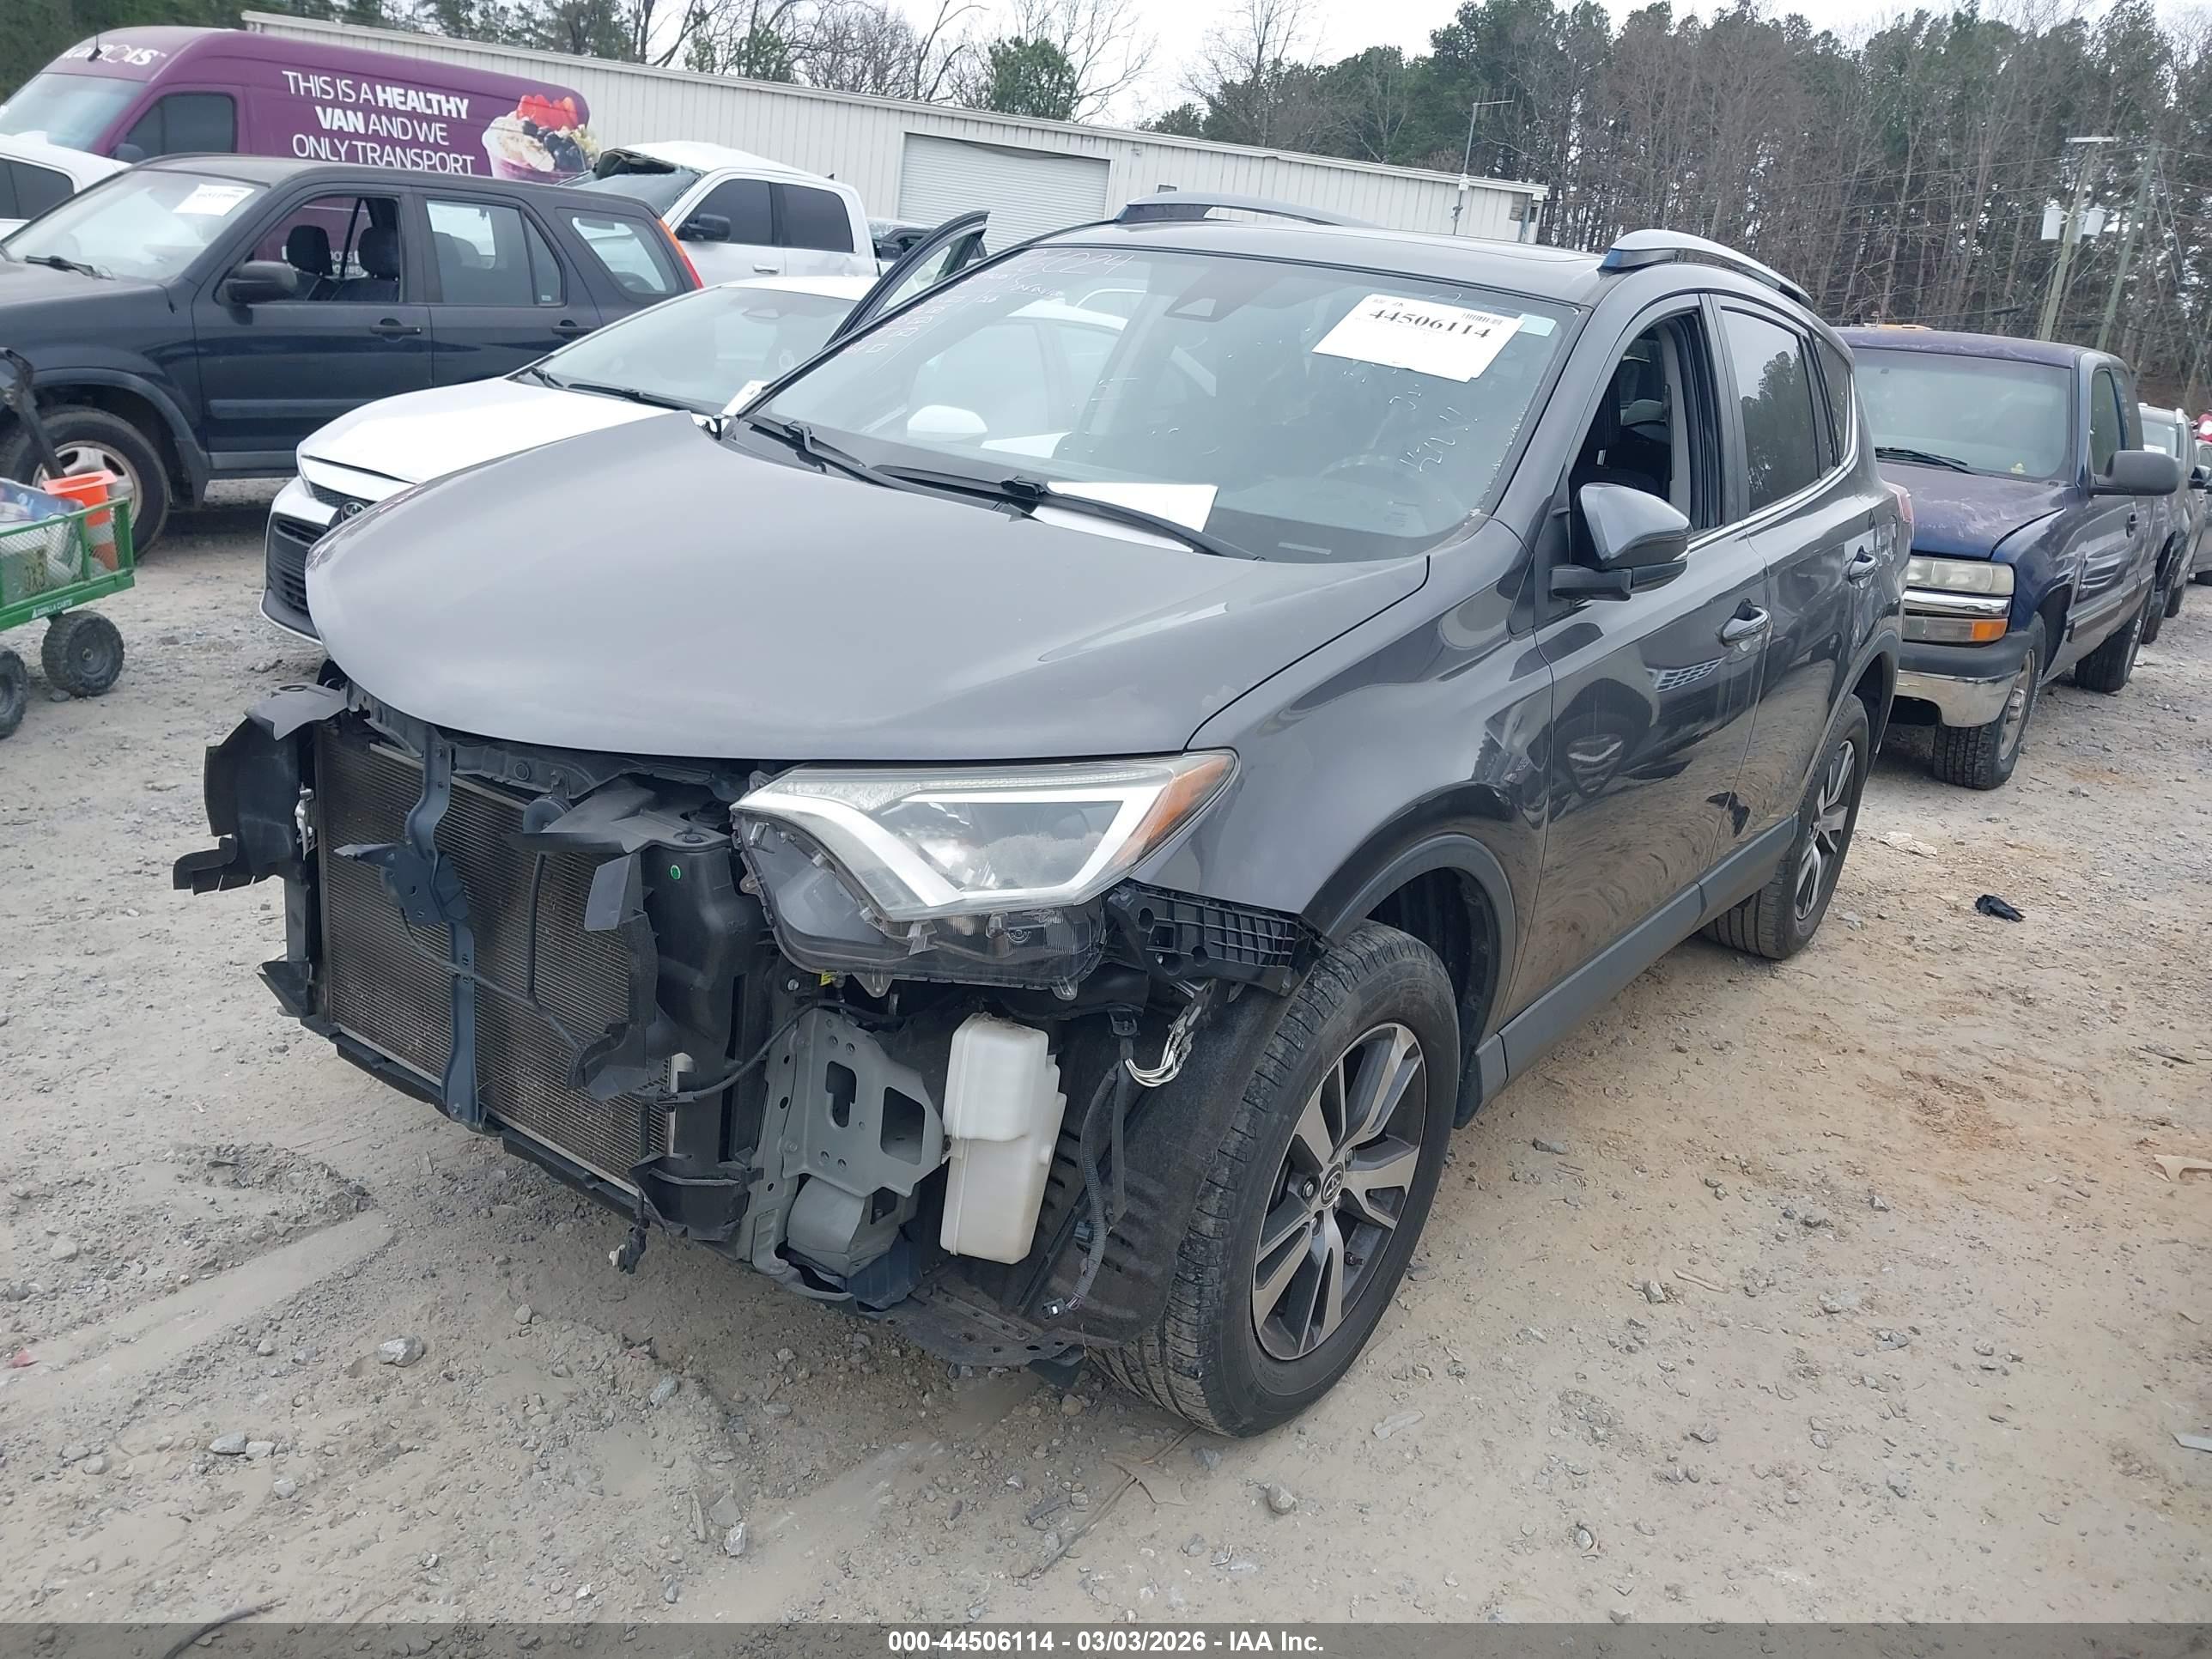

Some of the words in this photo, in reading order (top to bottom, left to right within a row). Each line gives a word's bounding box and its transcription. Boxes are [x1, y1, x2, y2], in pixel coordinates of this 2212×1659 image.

[282, 70, 333, 100] THIS
[336, 78, 356, 102] IS
[359, 82, 374, 106] A
[375, 84, 469, 119] HEALTHY
[315, 106, 364, 134] VAN
[368, 113, 411, 140] AND
[413, 119, 449, 145] WE
[292, 134, 349, 161] ONLY
[351, 141, 475, 175] TRANSPORT
[1370, 309, 1492, 338] 44506114
